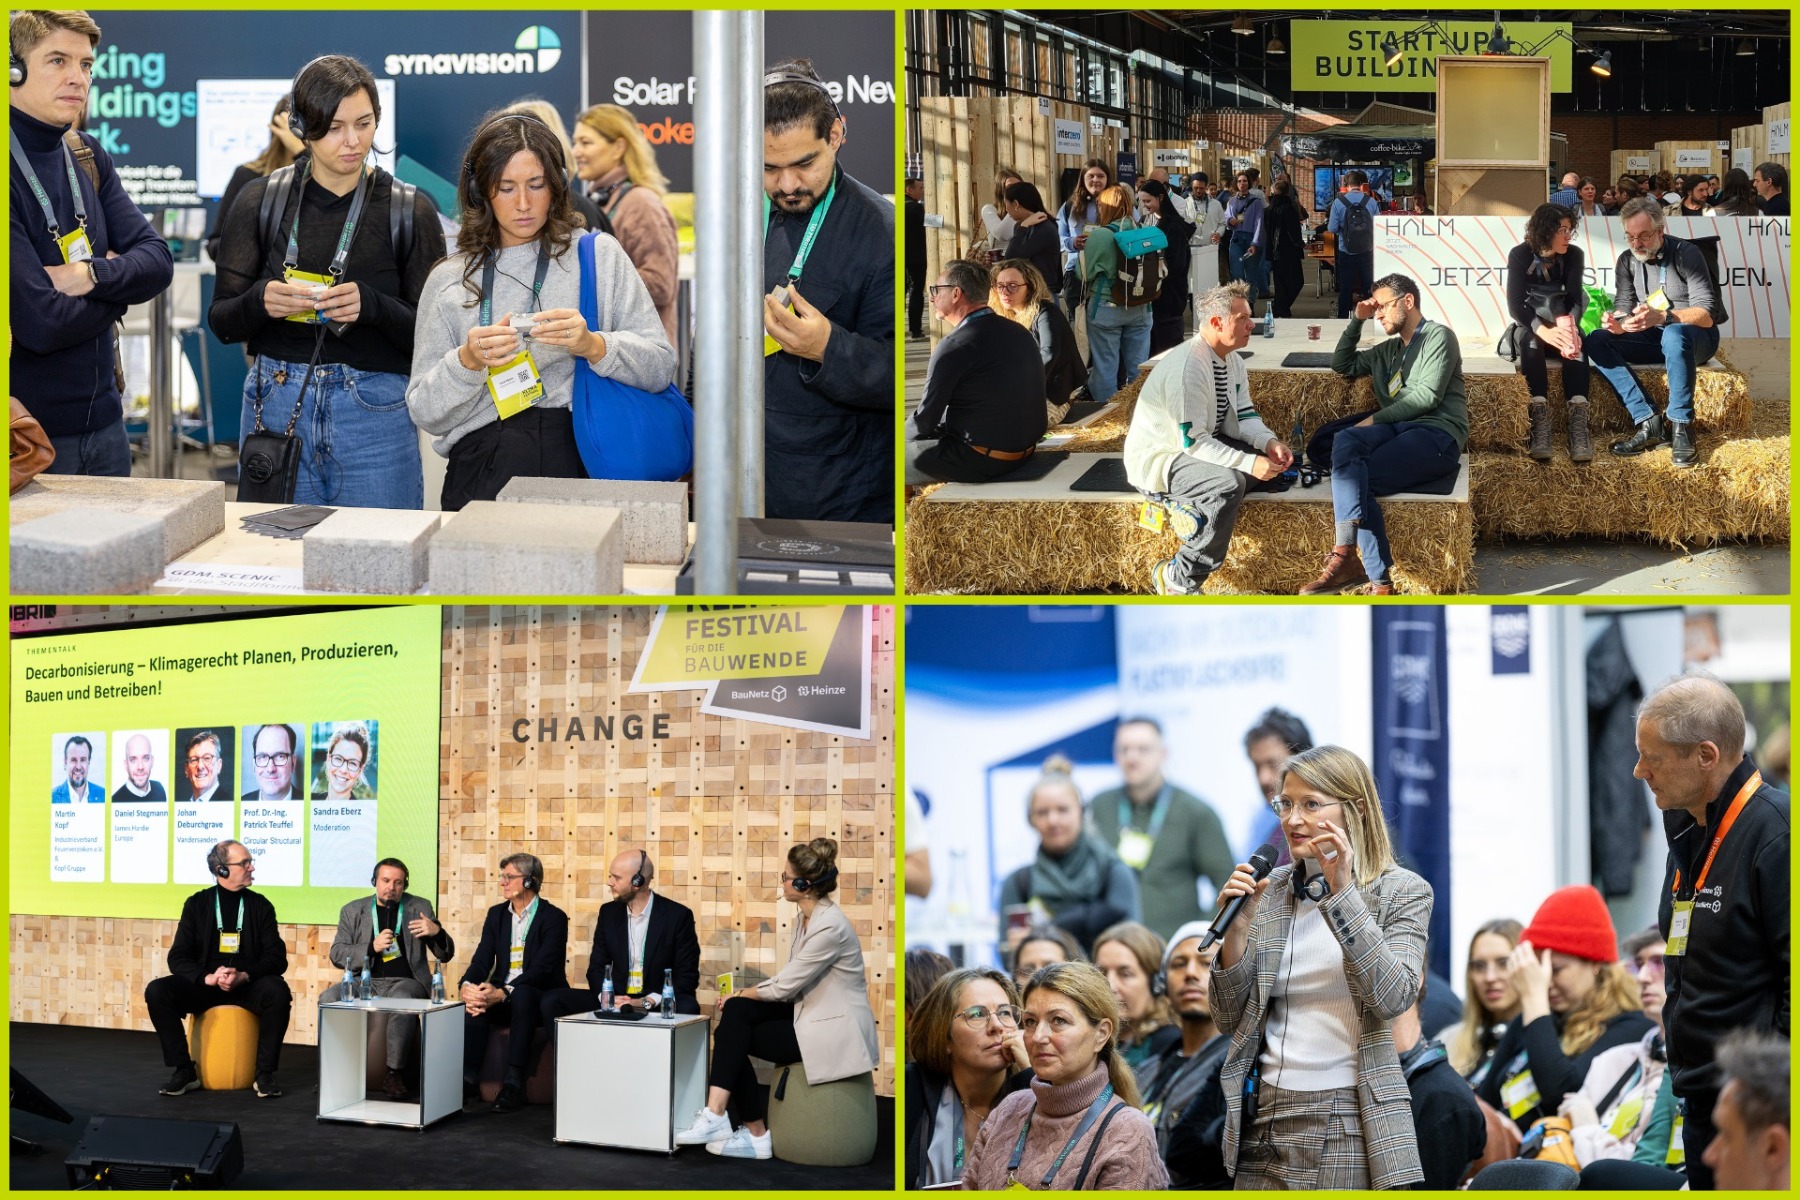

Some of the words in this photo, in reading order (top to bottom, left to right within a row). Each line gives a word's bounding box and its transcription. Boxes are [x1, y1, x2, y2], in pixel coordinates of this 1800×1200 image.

[1348, 29, 1490, 51] START-UP
[92, 44, 166, 89] king
[384, 52, 534, 76] synavision
[1315, 56, 1437, 78] BUILDIN
[613, 76, 685, 106] Solar
[89, 83, 197, 128] ldings
[1385, 218, 1454, 236] HALM
[1748, 218, 1791, 236] HAL
[1429, 267, 1510, 286] JETZT
[686, 611, 808, 640] FESTIVAL
[26, 645, 77, 655] THEMENTALK
[685, 643, 705, 654] FÜR
[707, 643, 725, 652] DIE
[25, 661, 135, 681] Decarbonisierung
[149, 651, 239, 673] Klimagerecht
[243, 649, 297, 666] Planen,
[301, 642, 399, 661] Produzieren,
[685, 650, 807, 673] BAUWENDE
[25, 689, 63, 703] Bauen
[66, 685, 90, 701] und
[94, 680, 163, 699] Betreiben!
[731, 690, 770, 700] BauNetz
[811, 685, 846, 696] Heinze
[512, 713, 671, 743] CHANGE
[55, 810, 76, 818] Martin
[114, 809, 135, 817] Daniel
[136, 809, 169, 820] Stegmann
[177, 809, 197, 817] Johan
[262, 808, 288, 818] Dr.-Ing.
[313, 807, 339, 816] Sandra
[341, 807, 362, 816] Eberz
[54, 821, 69, 830] Kopf
[177, 821, 223, 829] Deburchgrave
[244, 820, 267, 829] Patrick
[269, 820, 294, 829] Teuffel
[313, 824, 351, 832] Moderation
[177, 836, 218, 844] Vandersanden
[243, 837, 268, 845] Circular
[270, 837, 302, 845] Structural
